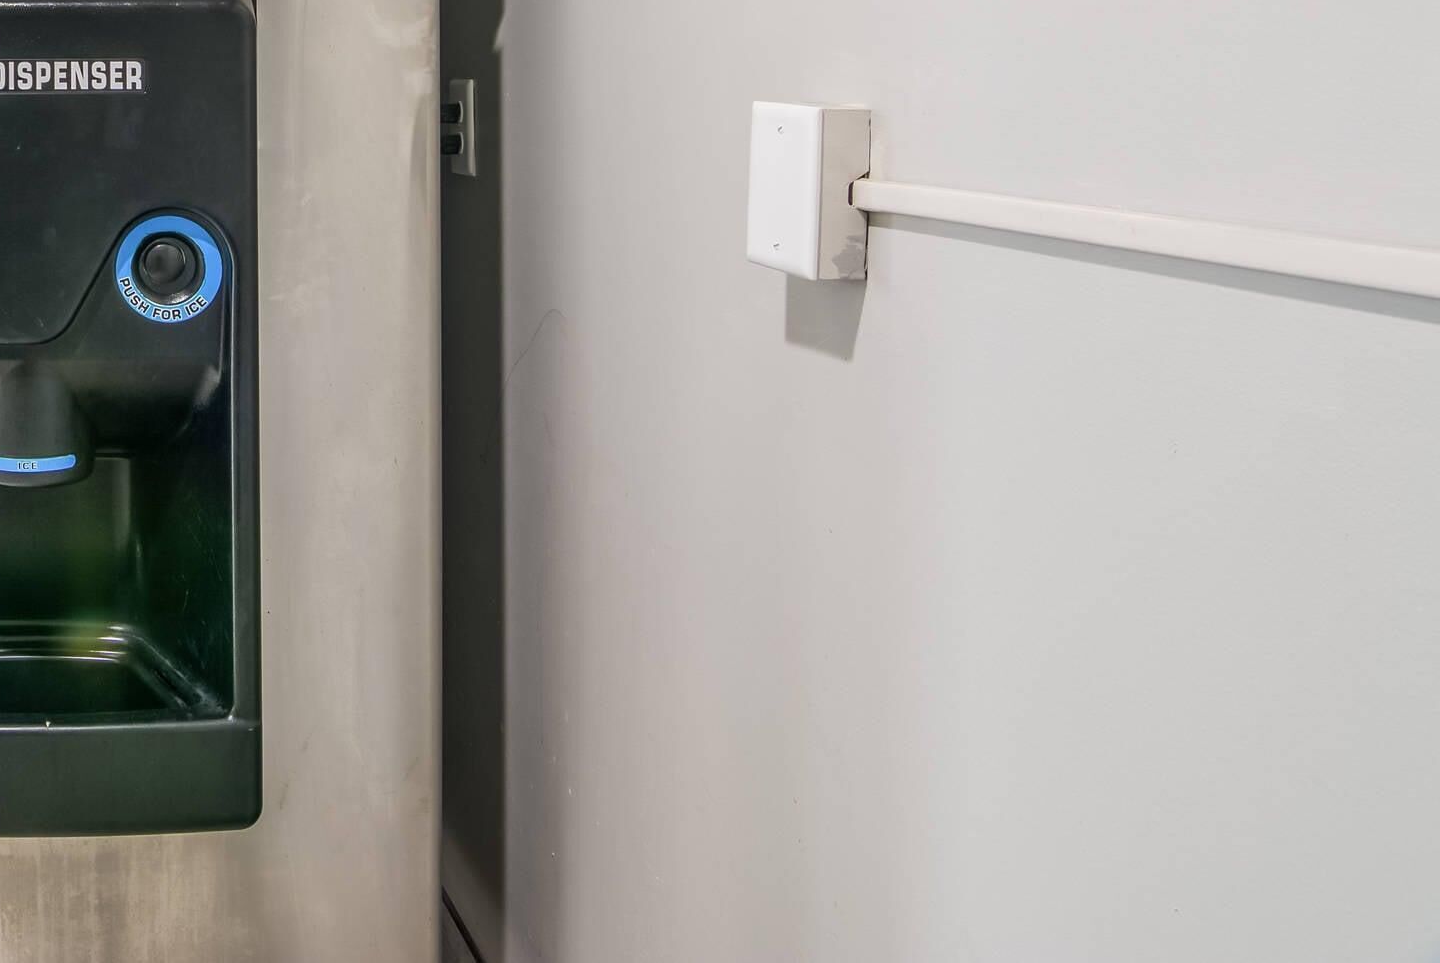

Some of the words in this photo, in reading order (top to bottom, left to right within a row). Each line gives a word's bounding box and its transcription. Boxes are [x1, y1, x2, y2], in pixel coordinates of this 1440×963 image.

[119, 277, 150, 314] PUSH
[152, 307, 182, 321] FOR
[185, 295, 208, 316] ICE
[17, 461, 38, 470] ICE
